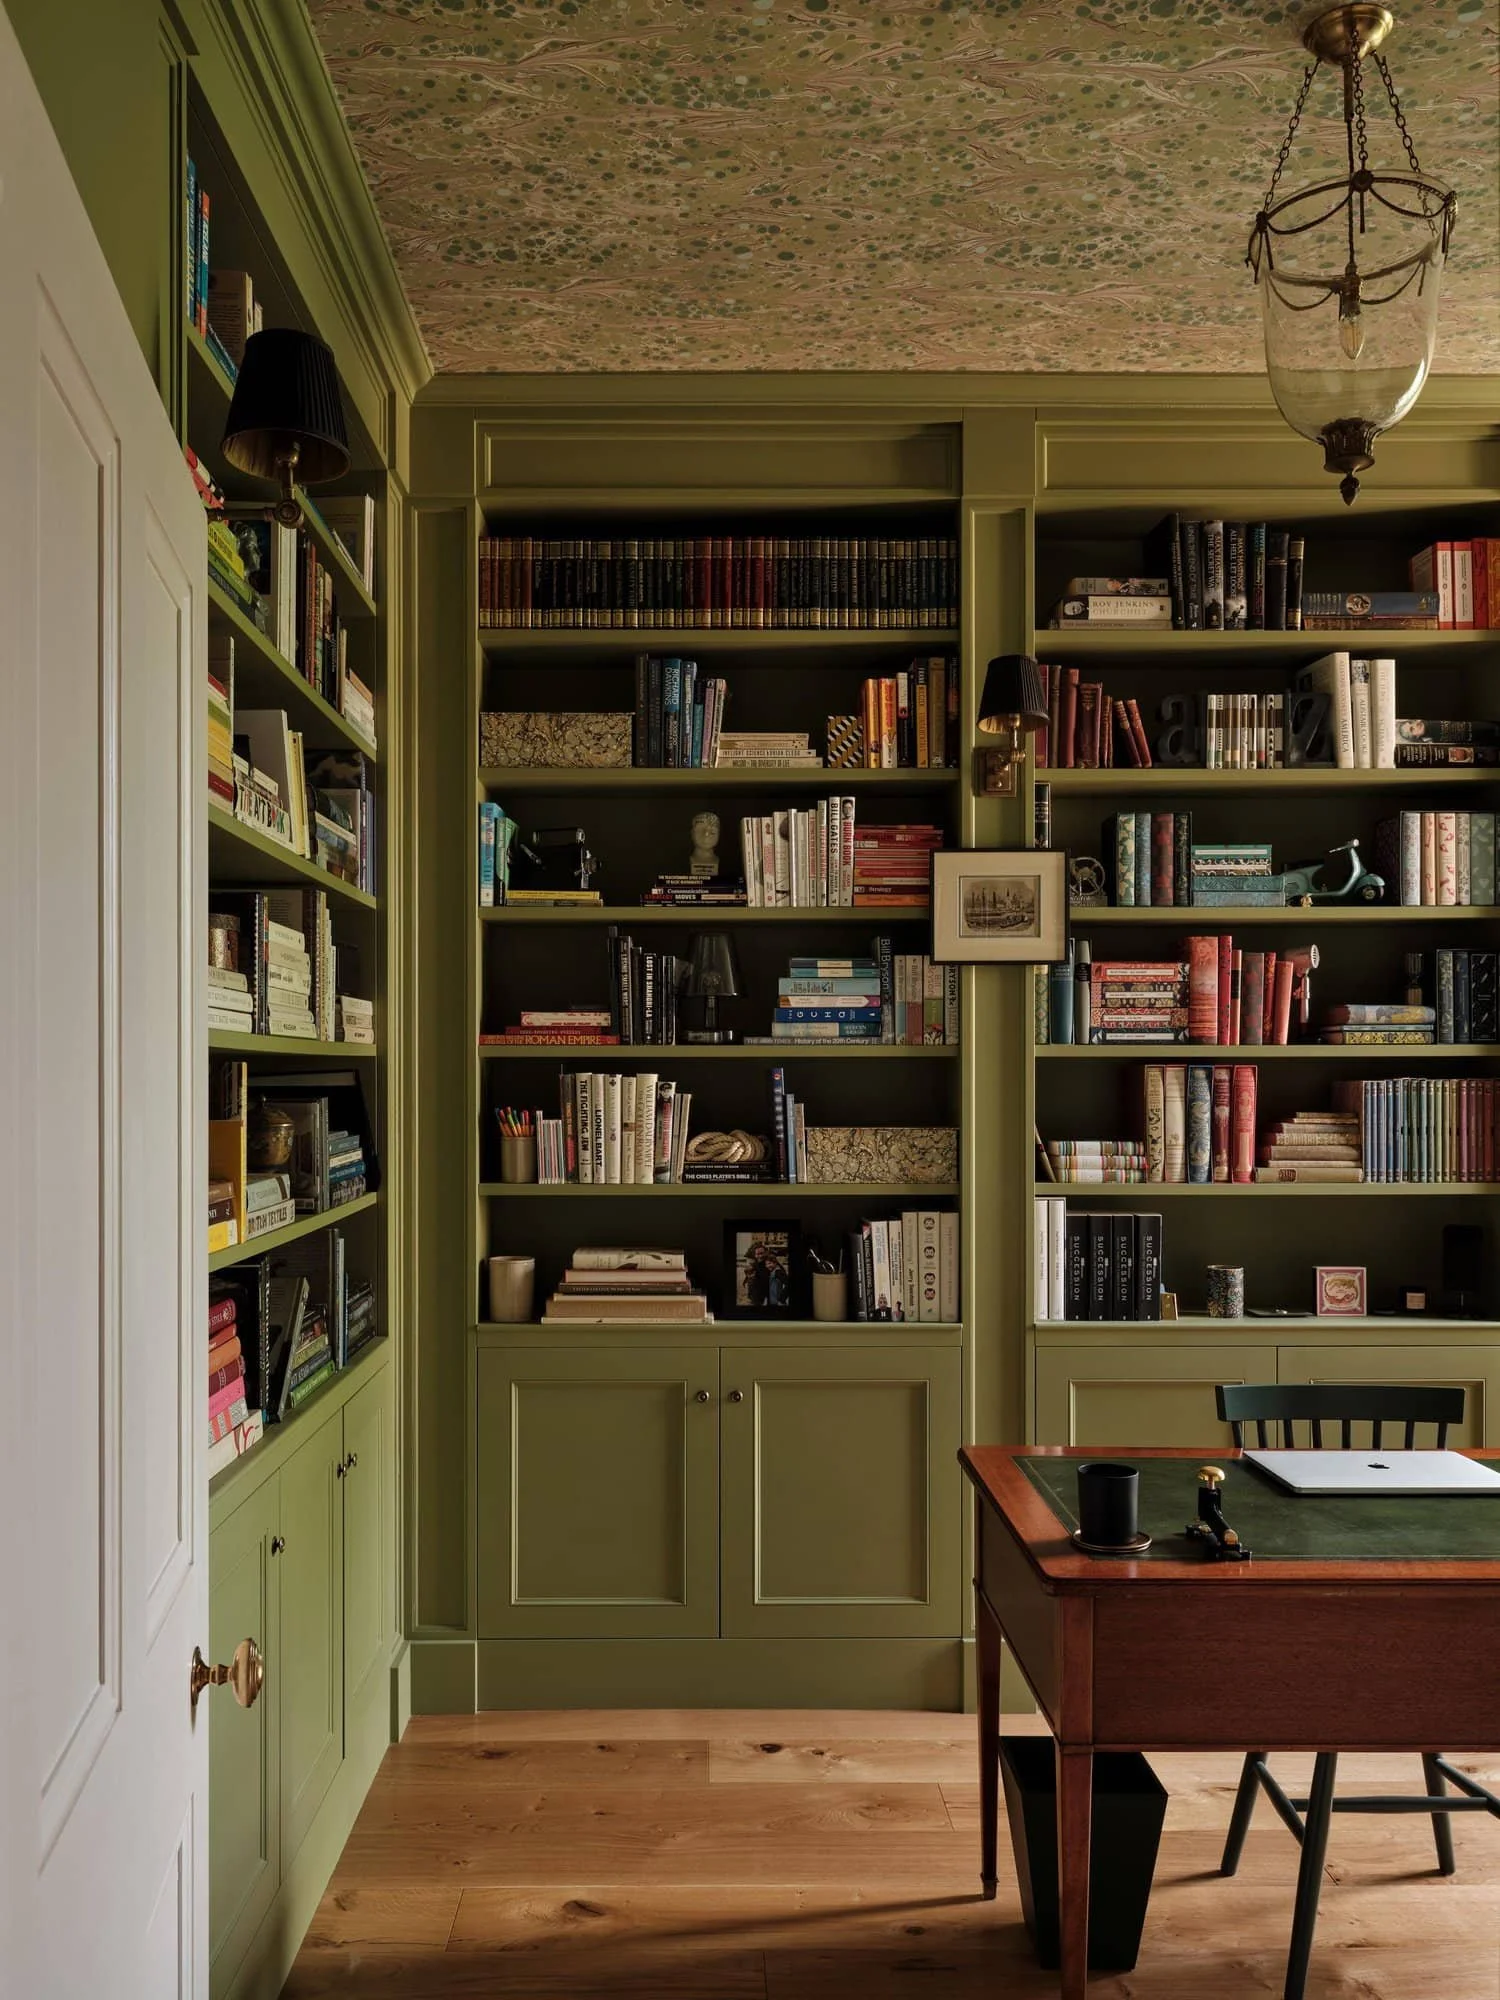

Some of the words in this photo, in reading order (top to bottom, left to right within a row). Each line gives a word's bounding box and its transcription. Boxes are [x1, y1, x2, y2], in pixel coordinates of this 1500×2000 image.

[1114, 600, 1154, 608] JENKINS
[664, 667, 672, 705] DAWKINS
[672, 668, 680, 705] RICHARD
[1340, 717, 1349, 753] AMERICA
[830, 803, 839, 823] BILL
[830, 824, 839, 854] GATES
[843, 821, 853, 843] BURN
[842, 844, 852, 866] BOOK
[881, 938, 891, 954] Bill
[879, 954, 891, 990] Bryson
[645, 981, 653, 1018] SHANGRI-LA
[525, 1035, 566, 1045] ROMAN
[580, 1080, 588, 1093] THE
[580, 1095, 588, 1134] FIGHTING
[645, 1084, 653, 1120] WILLIAM
[595, 1143, 603, 1168] BART
[644, 1122, 653, 1168] DALRYMPLE
